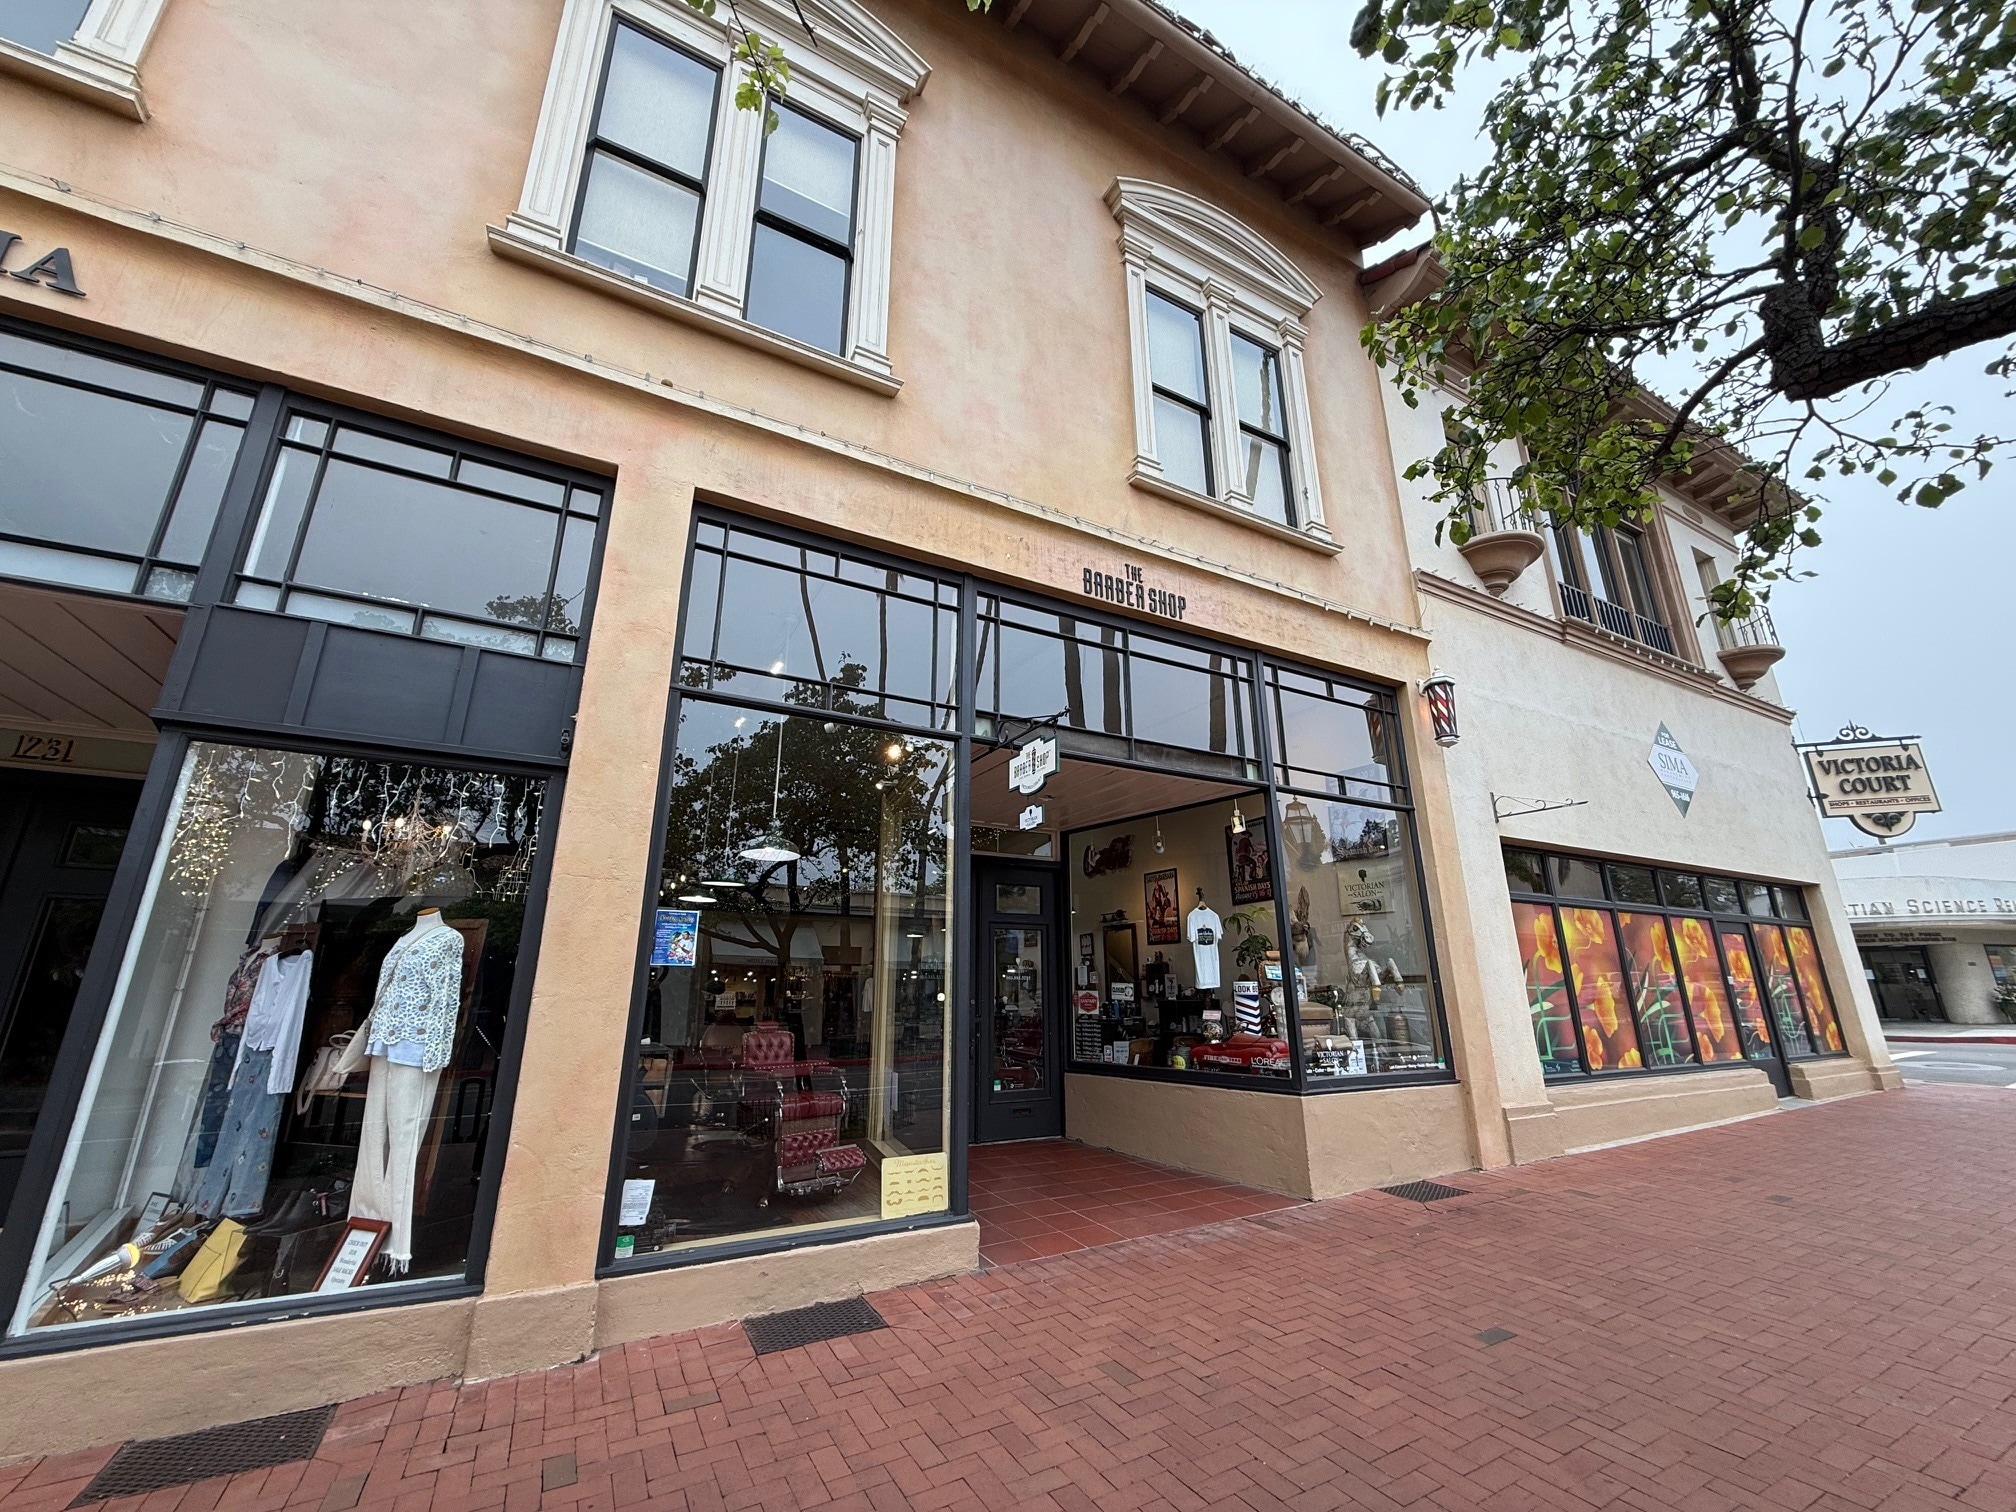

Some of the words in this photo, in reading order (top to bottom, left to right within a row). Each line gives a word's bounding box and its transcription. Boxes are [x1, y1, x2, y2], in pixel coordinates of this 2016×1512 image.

[1125, 563, 1143, 583] THE
[1083, 567, 1145, 610] BARBER
[1148, 587, 1186, 620] SHOP
[1657, 736, 1677, 749] LEASE
[1657, 752, 1688, 775] SIMA
[1817, 754, 1922, 776] VICTORIA
[1839, 774, 1912, 794] COURT
[1855, 798, 1899, 806] RESTAURANTS
[1235, 884, 1257, 893] SPANISH
[1257, 882, 1271, 890] DAYS
[1344, 881, 1385, 892] VICTORIAN
[1906, 898, 1988, 914] SCIENCE
[1234, 985, 1251, 993] LOOK
[1316, 1050, 1344, 1058] VICTORIAN
